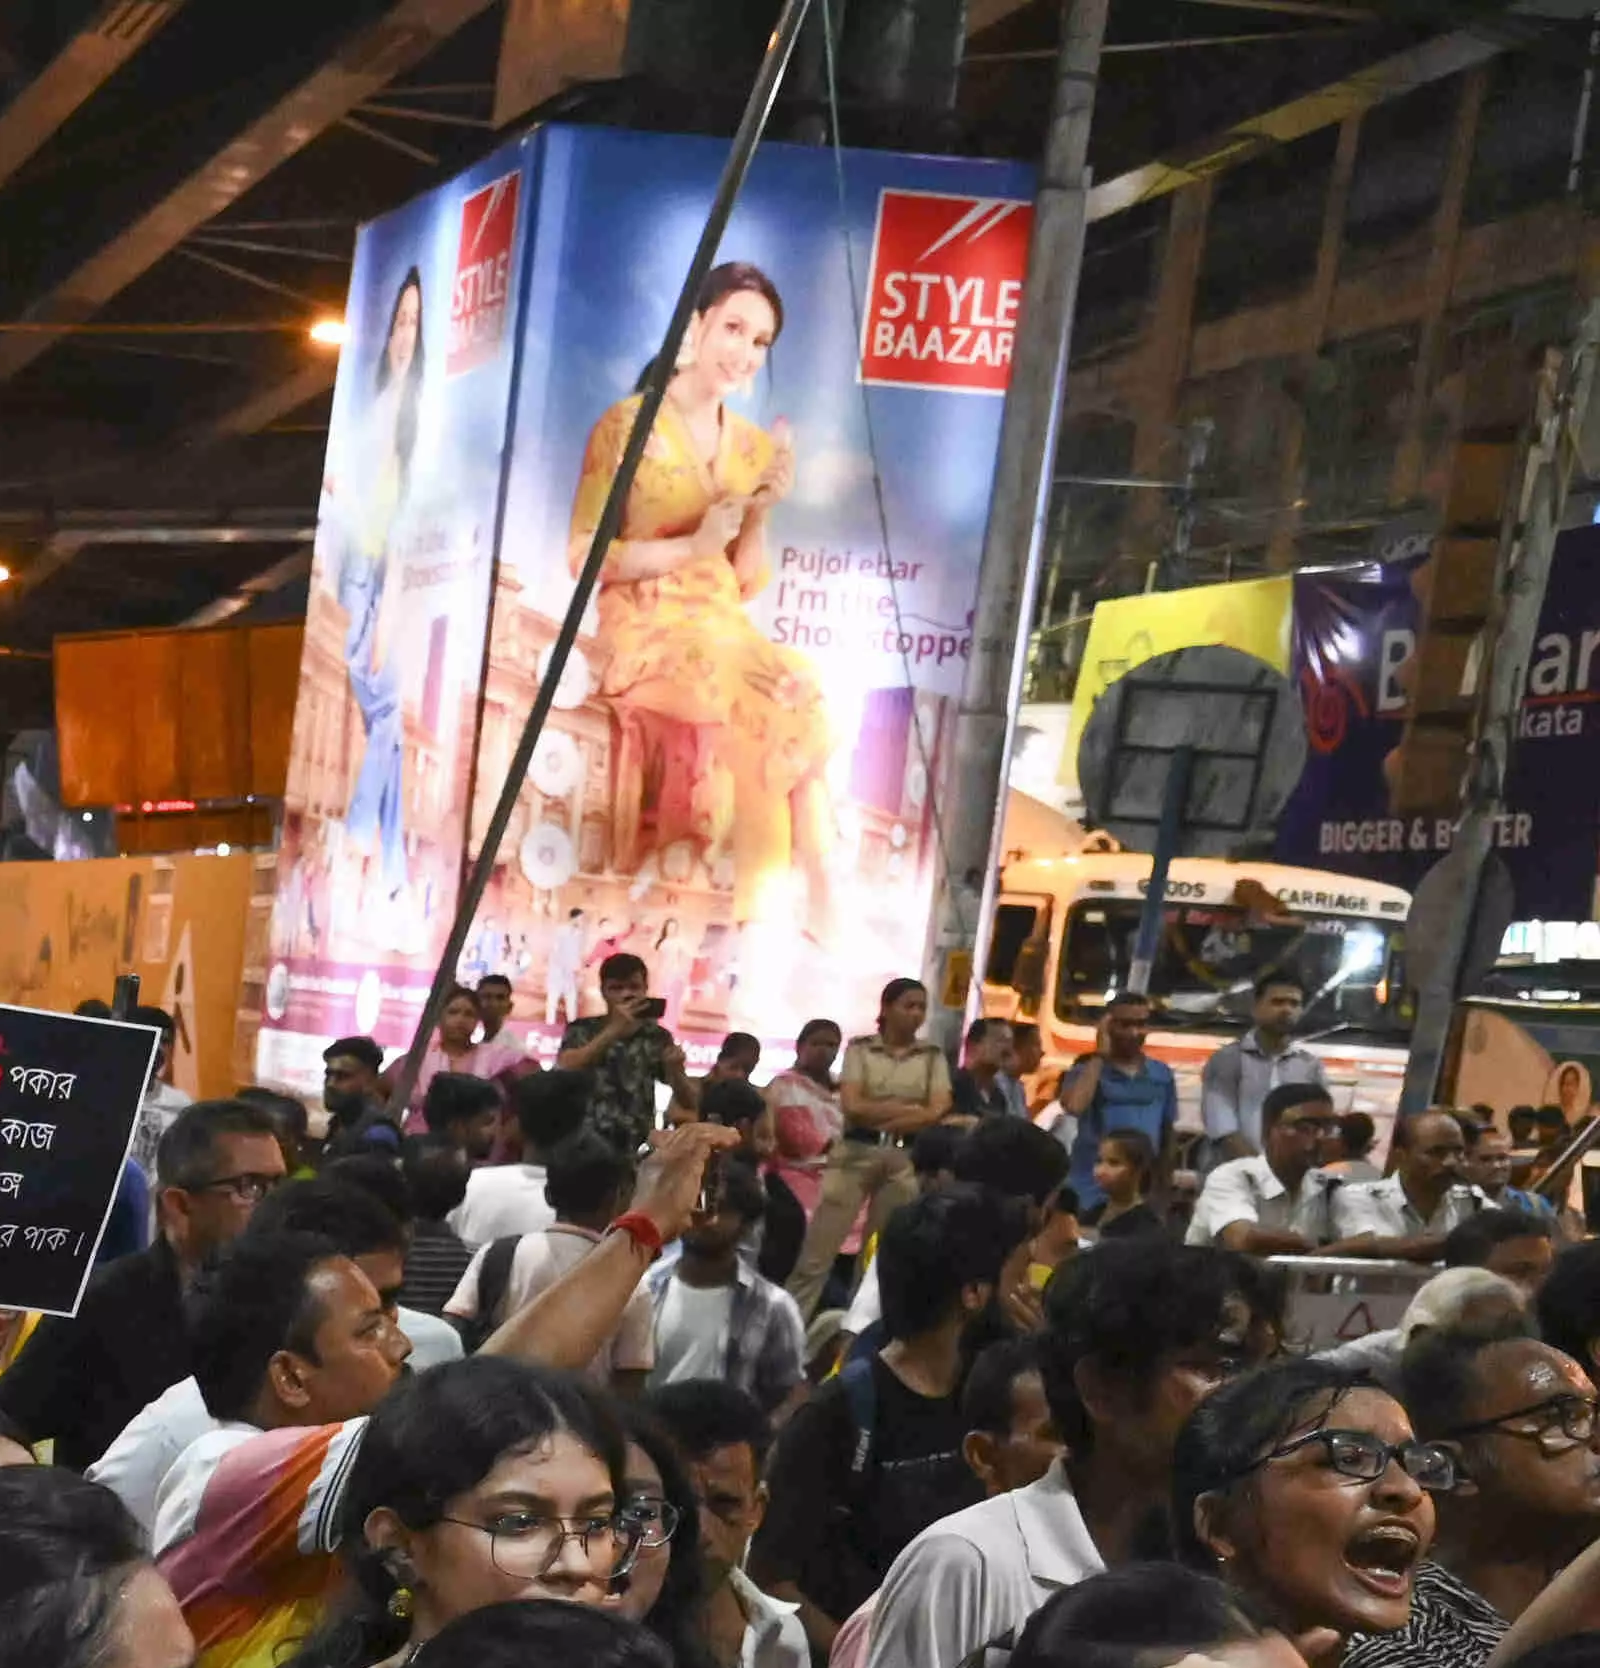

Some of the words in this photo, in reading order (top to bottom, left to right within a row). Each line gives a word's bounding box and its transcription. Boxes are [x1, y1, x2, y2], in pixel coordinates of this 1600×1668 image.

[880, 271, 1022, 328] STYLE
[873, 321, 1016, 368] BAAZAR
[1520, 705, 1583, 738] kata
[1320, 819, 1405, 853] BIGGER
[1138, 879, 1206, 898] GODS
[1, 1116, 57, 1151] কাজ
